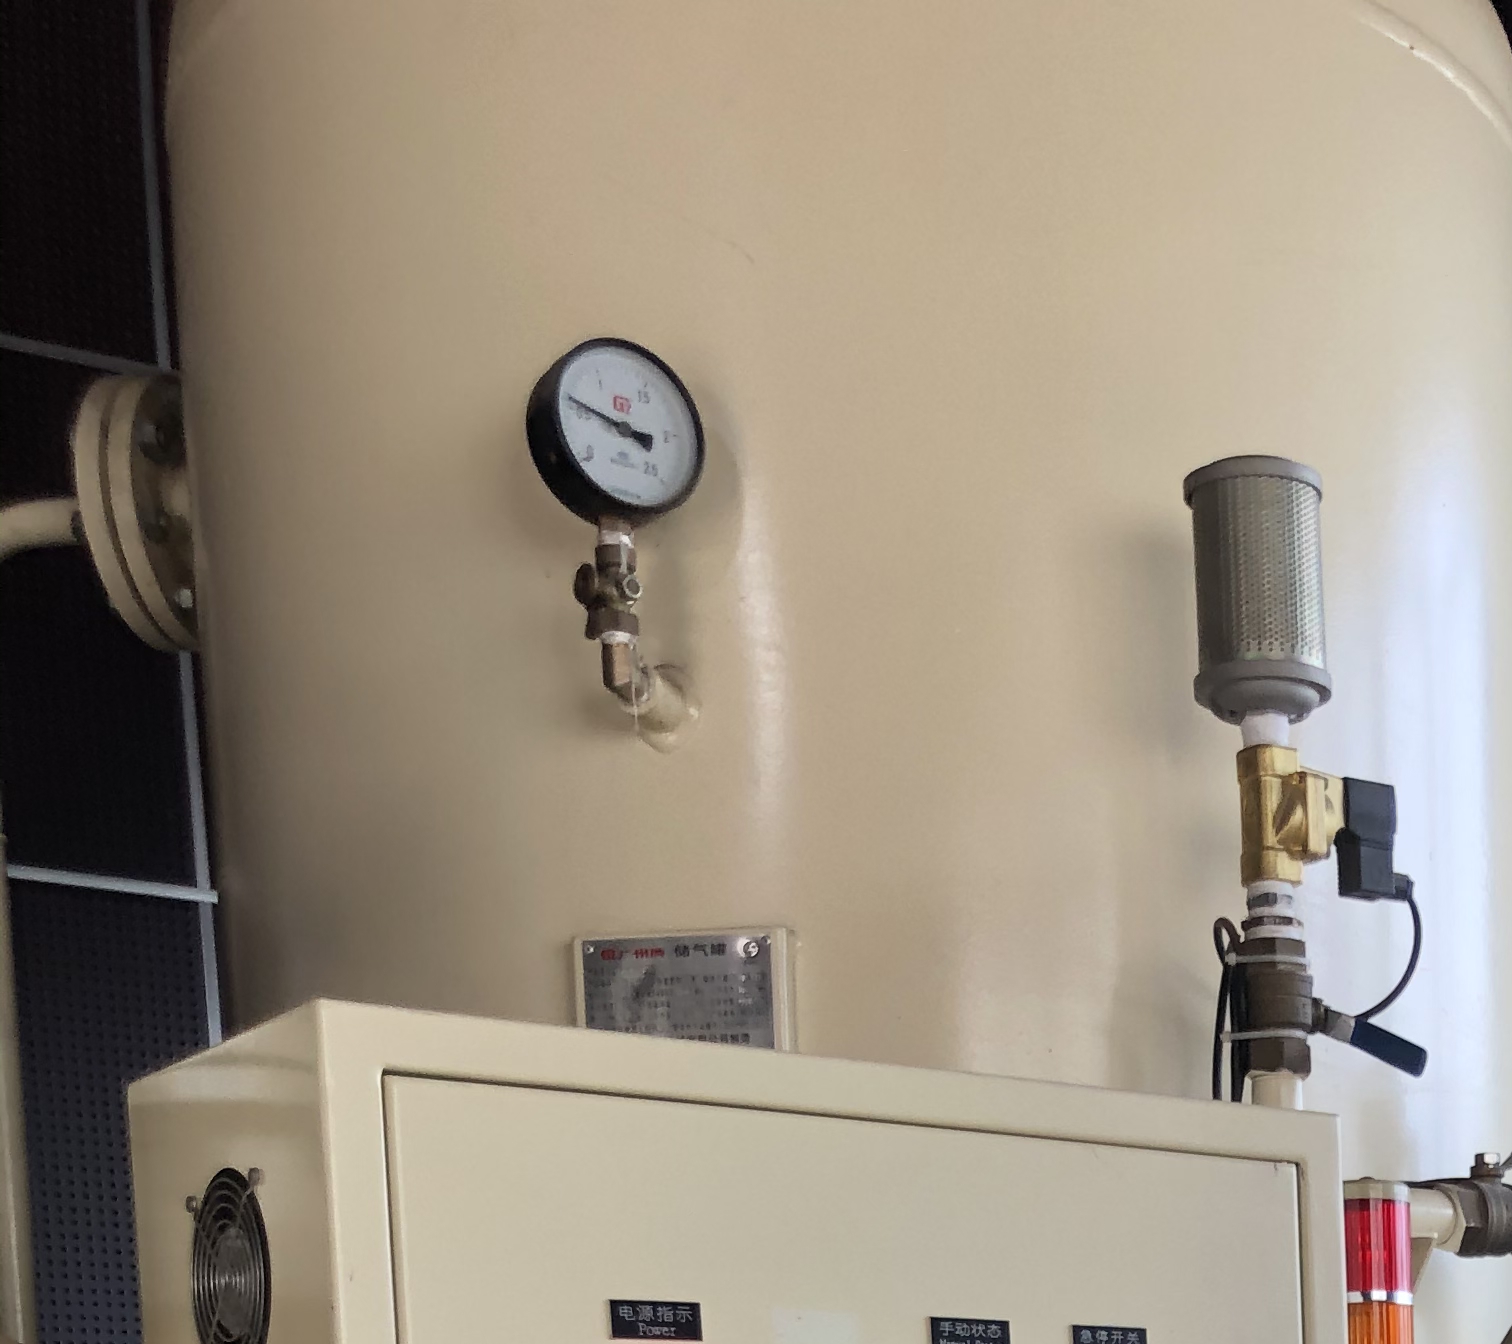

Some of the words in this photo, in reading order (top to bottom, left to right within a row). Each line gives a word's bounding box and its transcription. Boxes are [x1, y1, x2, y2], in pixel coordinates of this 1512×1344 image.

[618, 1304, 693, 1323] 电源指示
[638, 1322, 677, 1337] Power
[939, 1321, 1002, 1339] 手动状态
